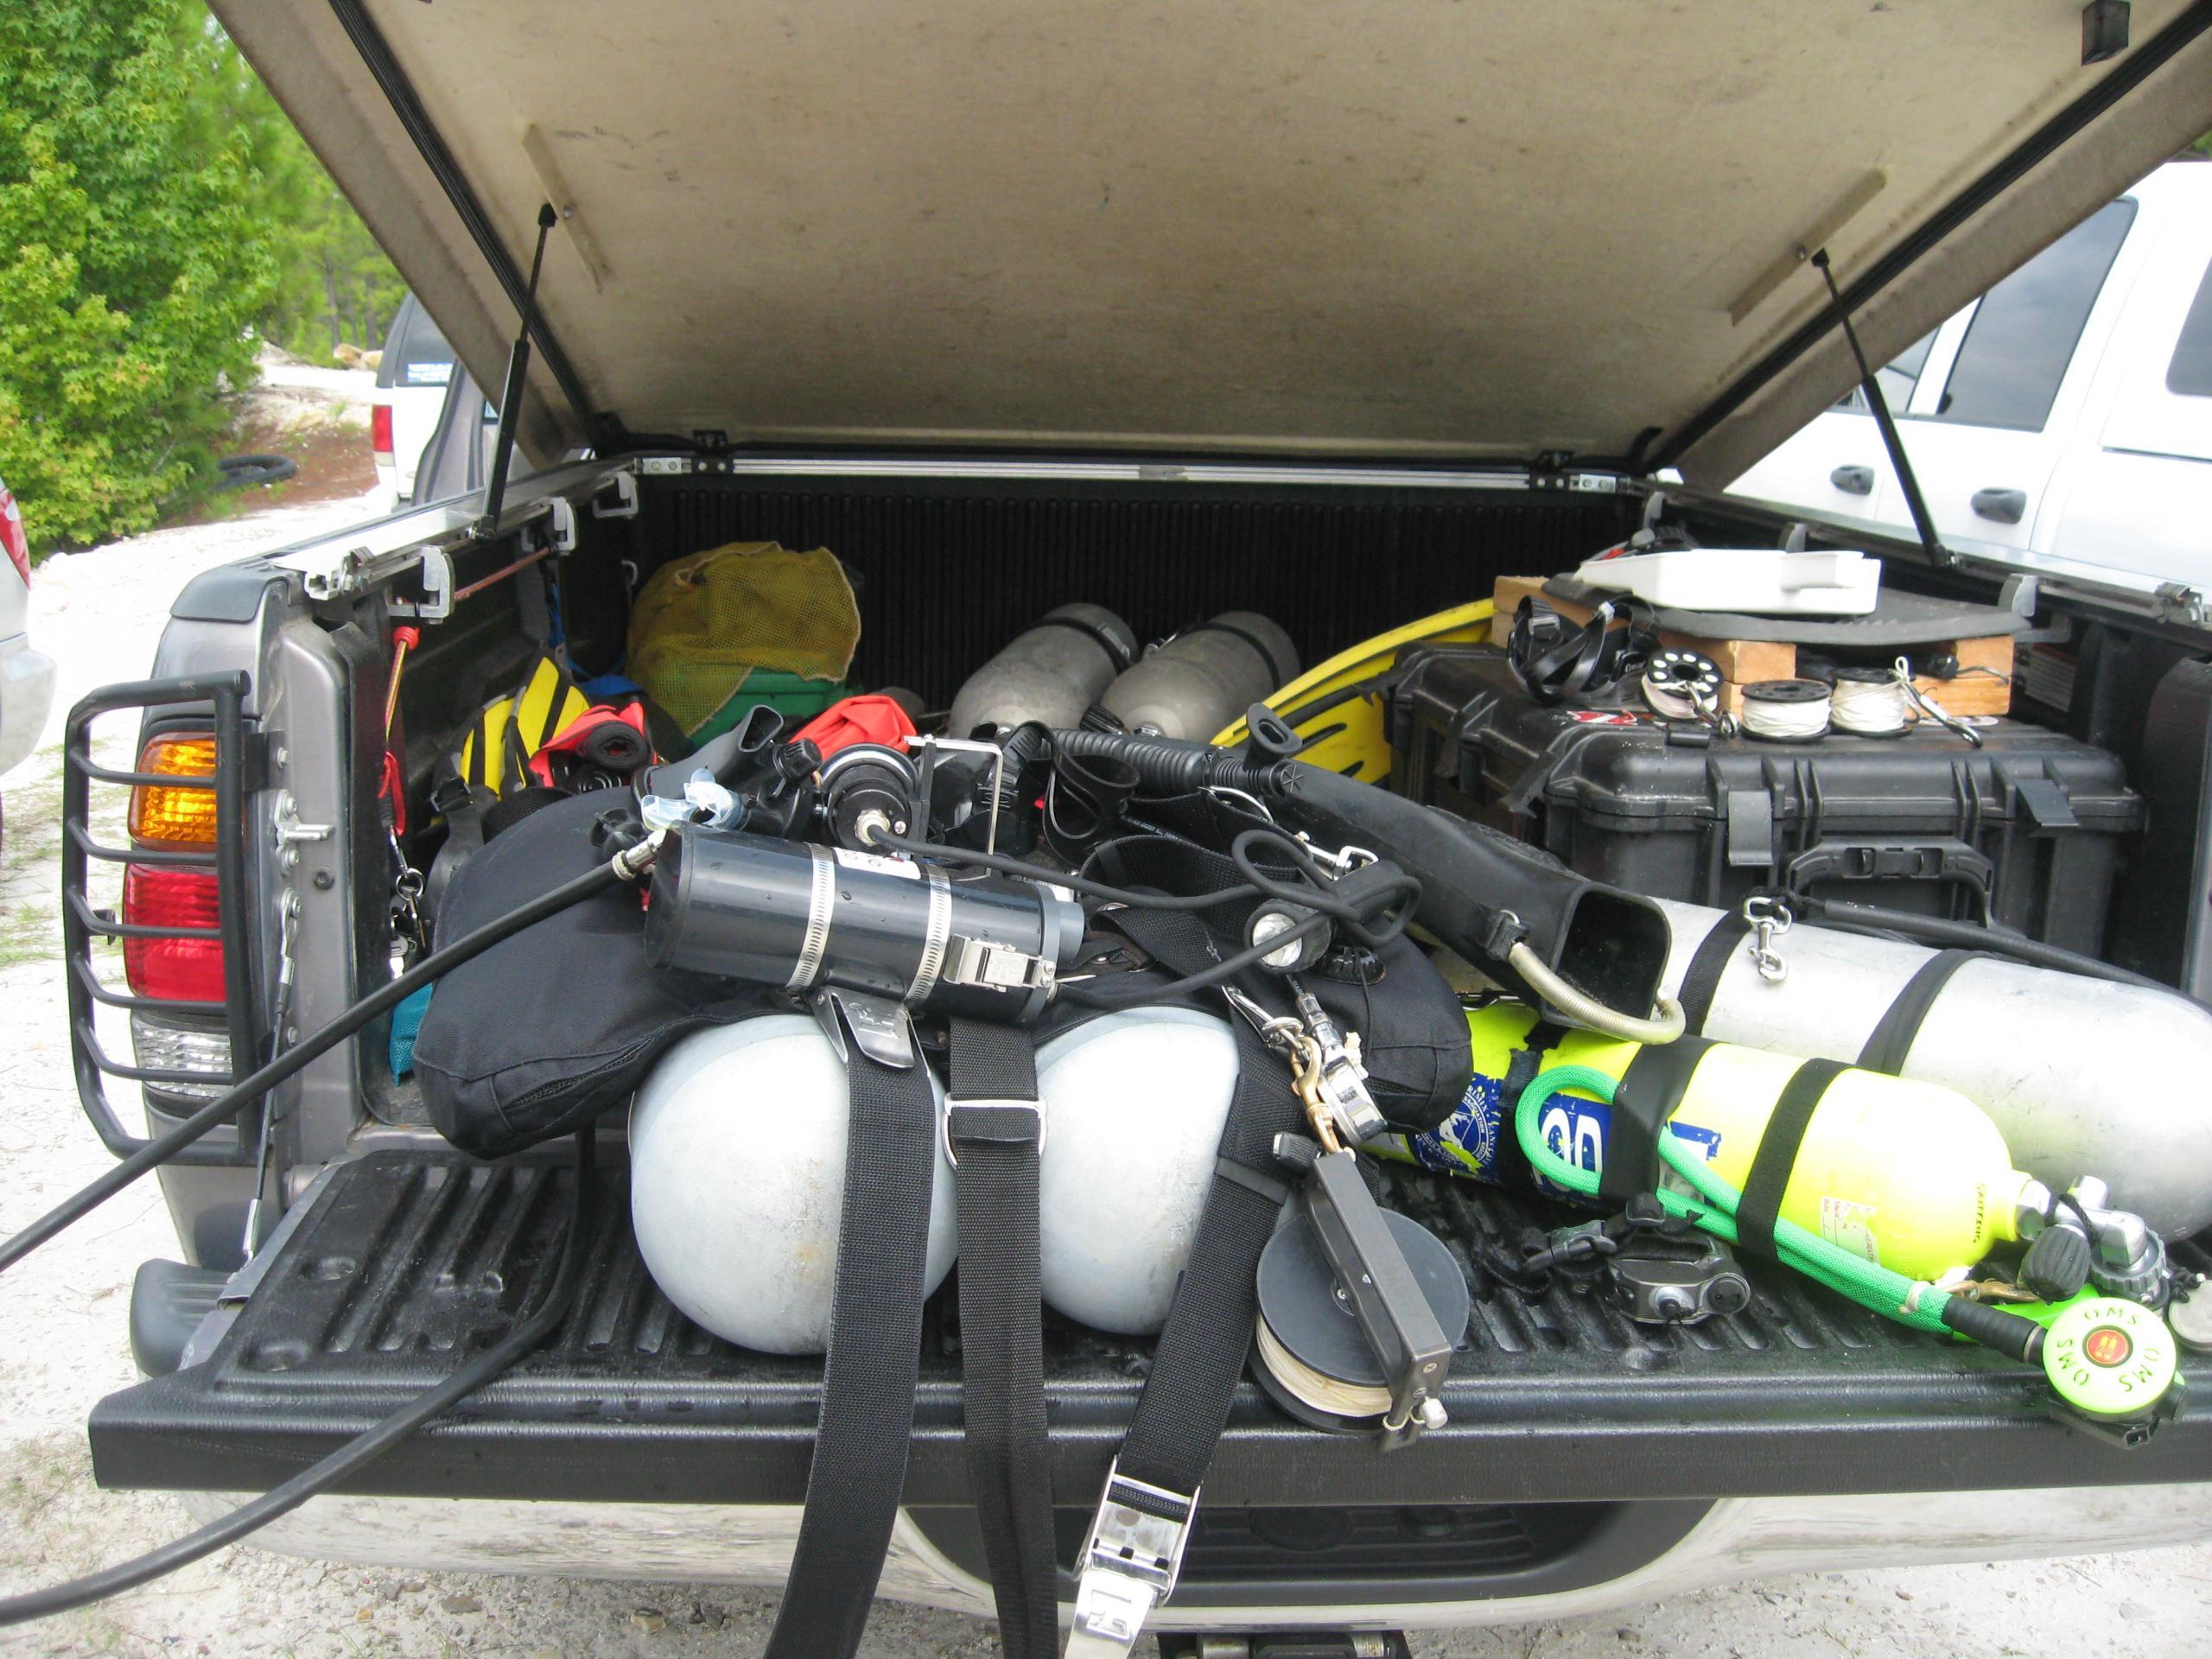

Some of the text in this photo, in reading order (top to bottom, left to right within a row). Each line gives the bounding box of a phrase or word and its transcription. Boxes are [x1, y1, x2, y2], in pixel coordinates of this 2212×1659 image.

[1463, 1096, 1485, 1134] SSOCIATION
[2083, 1306, 2143, 1325] OMS
[2056, 1337, 2090, 1387] OMS
[2118, 1347, 2160, 1393] OMS
